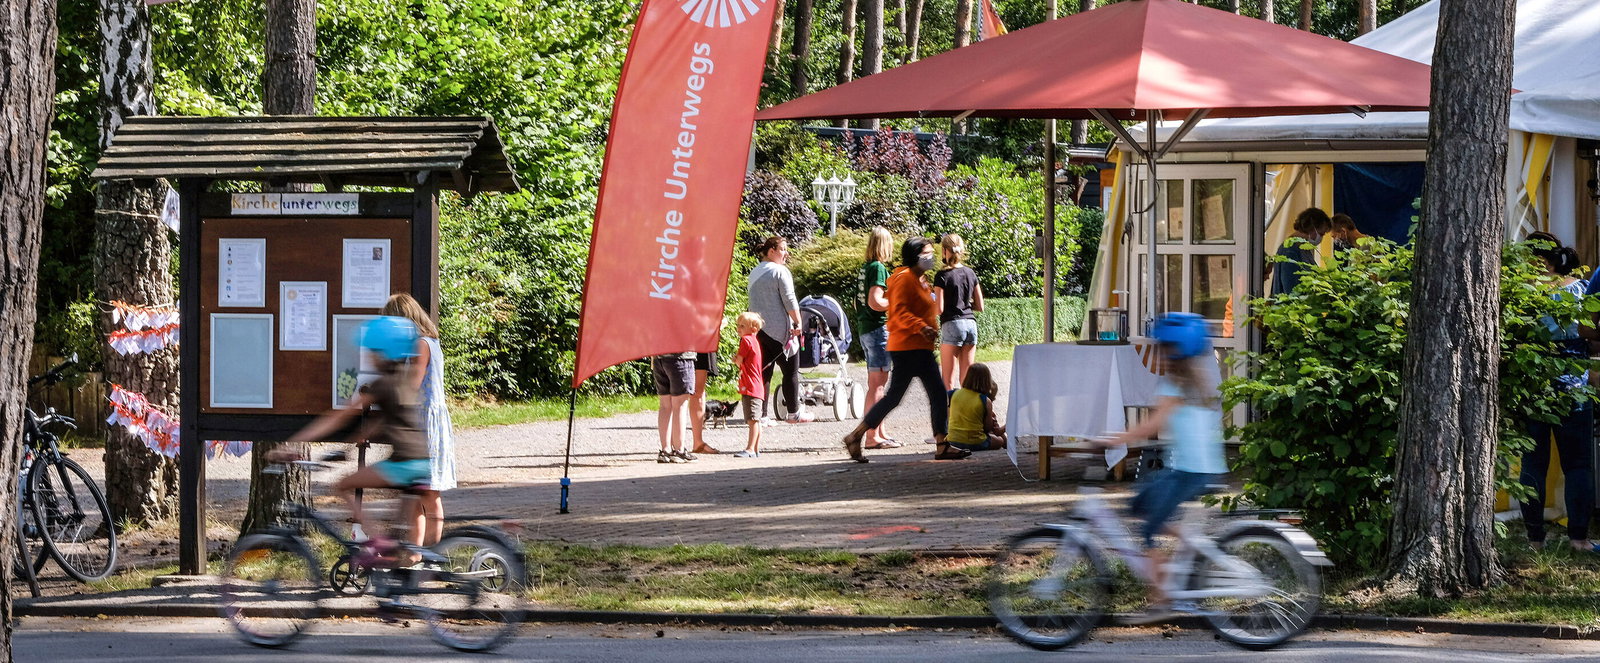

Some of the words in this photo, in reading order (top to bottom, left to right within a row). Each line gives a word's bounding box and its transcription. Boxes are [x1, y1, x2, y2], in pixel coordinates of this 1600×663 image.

[664, 42, 714, 200] Unterwegs
[232, 195, 278, 210] Kirche
[282, 198, 358, 212] unterwegs
[649, 210, 683, 300] Kirche
